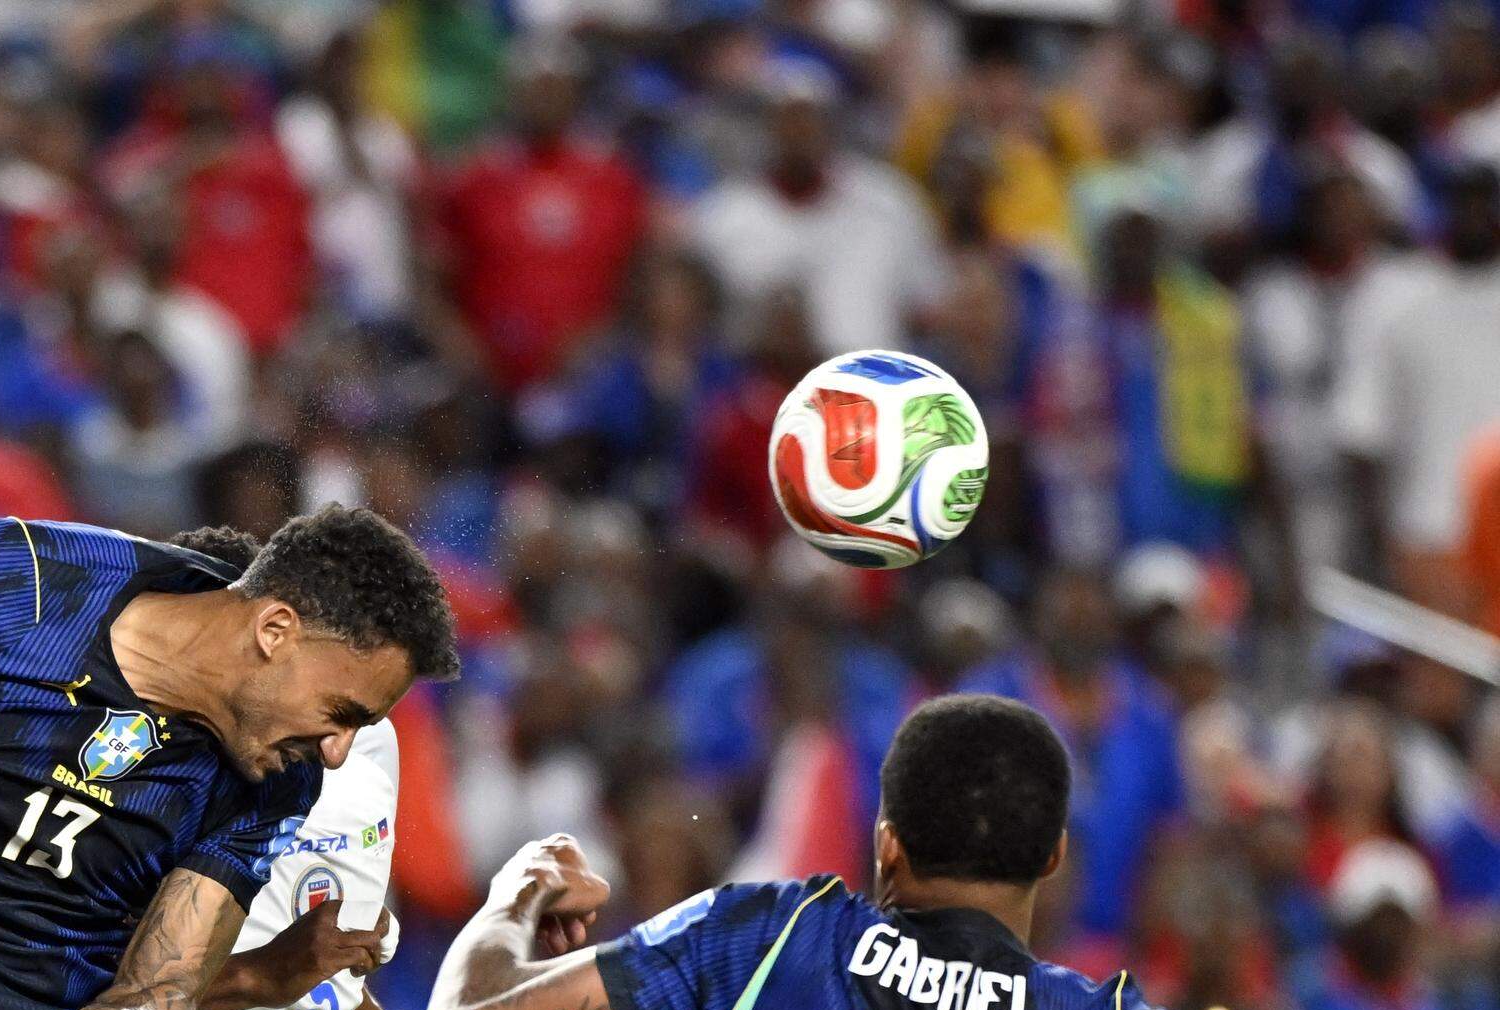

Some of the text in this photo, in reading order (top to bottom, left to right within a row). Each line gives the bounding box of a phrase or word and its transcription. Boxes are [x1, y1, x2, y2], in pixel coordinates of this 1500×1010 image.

[109, 737, 130, 754] CBF
[51, 764, 115, 808] BRASIL
[1, 785, 102, 880] 13
